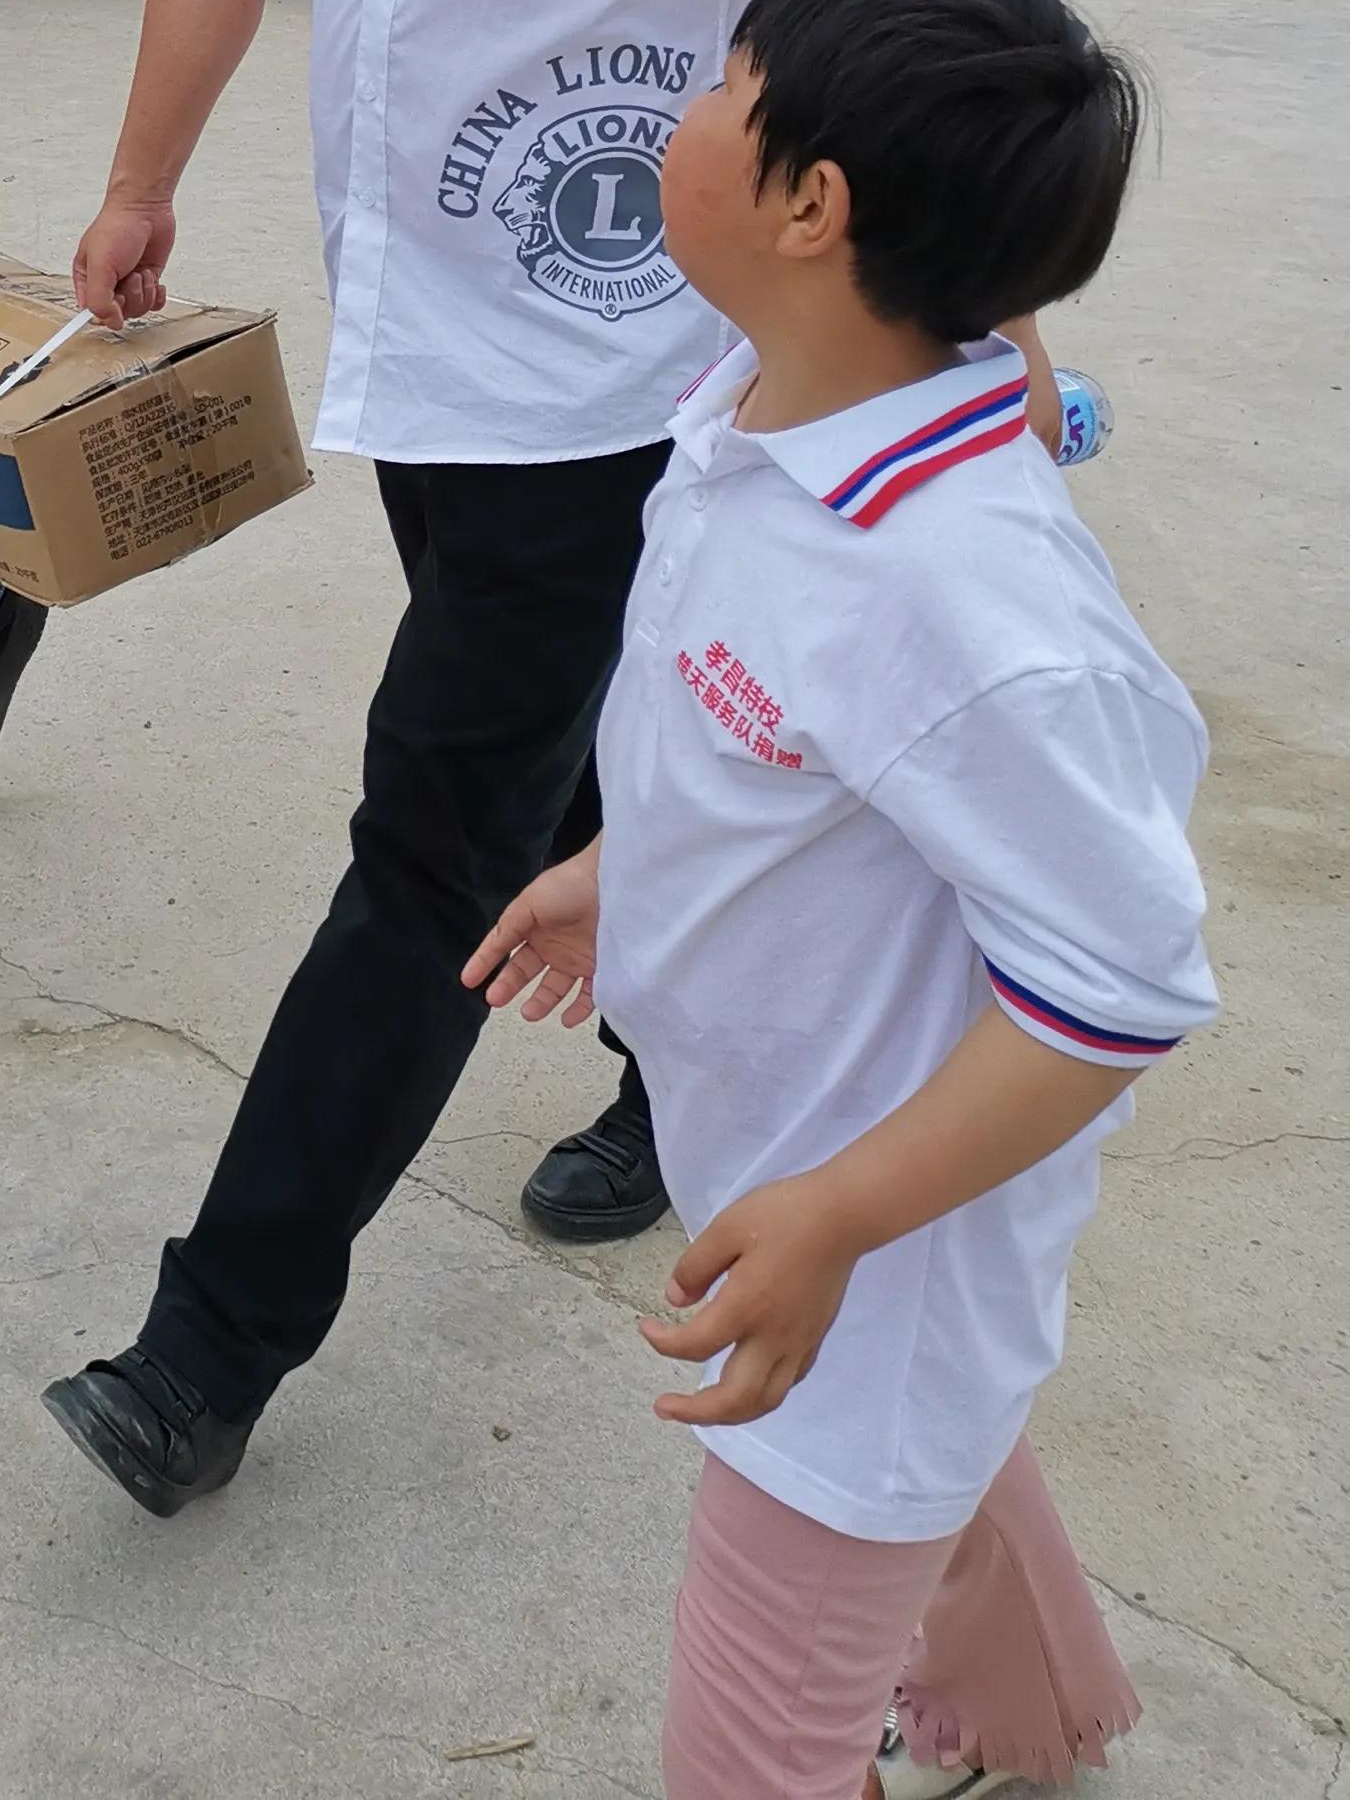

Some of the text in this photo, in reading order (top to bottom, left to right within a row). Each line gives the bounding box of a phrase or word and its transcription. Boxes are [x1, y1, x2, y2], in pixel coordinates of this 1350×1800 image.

[438, 43, 696, 218] CHINA LIONS
[584, 173, 642, 240] L
[541, 260, 677, 301] INTERNATIONAL
[705, 640, 785, 737] 孝昌特校
